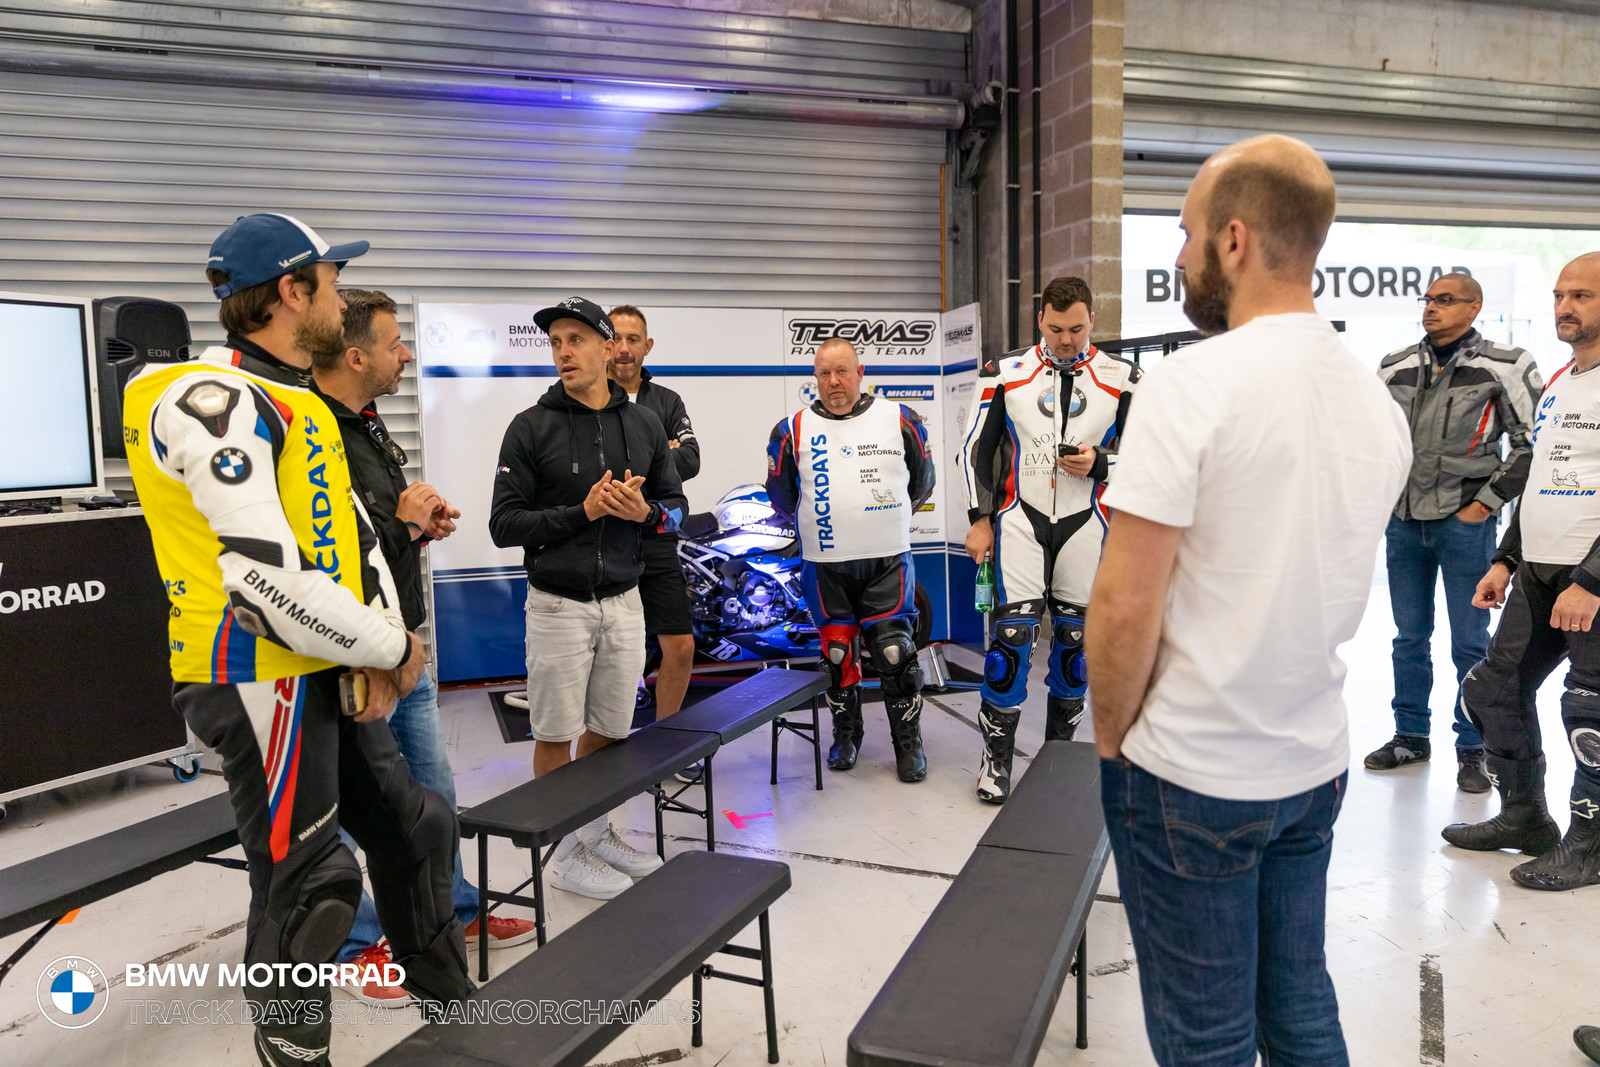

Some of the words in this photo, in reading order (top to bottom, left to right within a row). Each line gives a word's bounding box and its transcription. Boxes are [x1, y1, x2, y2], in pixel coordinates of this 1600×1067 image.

[509, 325, 537, 335] BMW
[789, 319, 936, 346] TECMAS
[147, 349, 171, 358] EON
[875, 347, 926, 355] TEAM
[886, 389, 934, 398] MICHELIN
[1564, 413, 1581, 421] BMW
[811, 434, 834, 552] TRACKDAYS
[243, 569, 291, 609] BMW
[286, 603, 358, 649] Motorrad
[708, 638, 738, 660] 78
[298, 825, 317, 842] BMW
